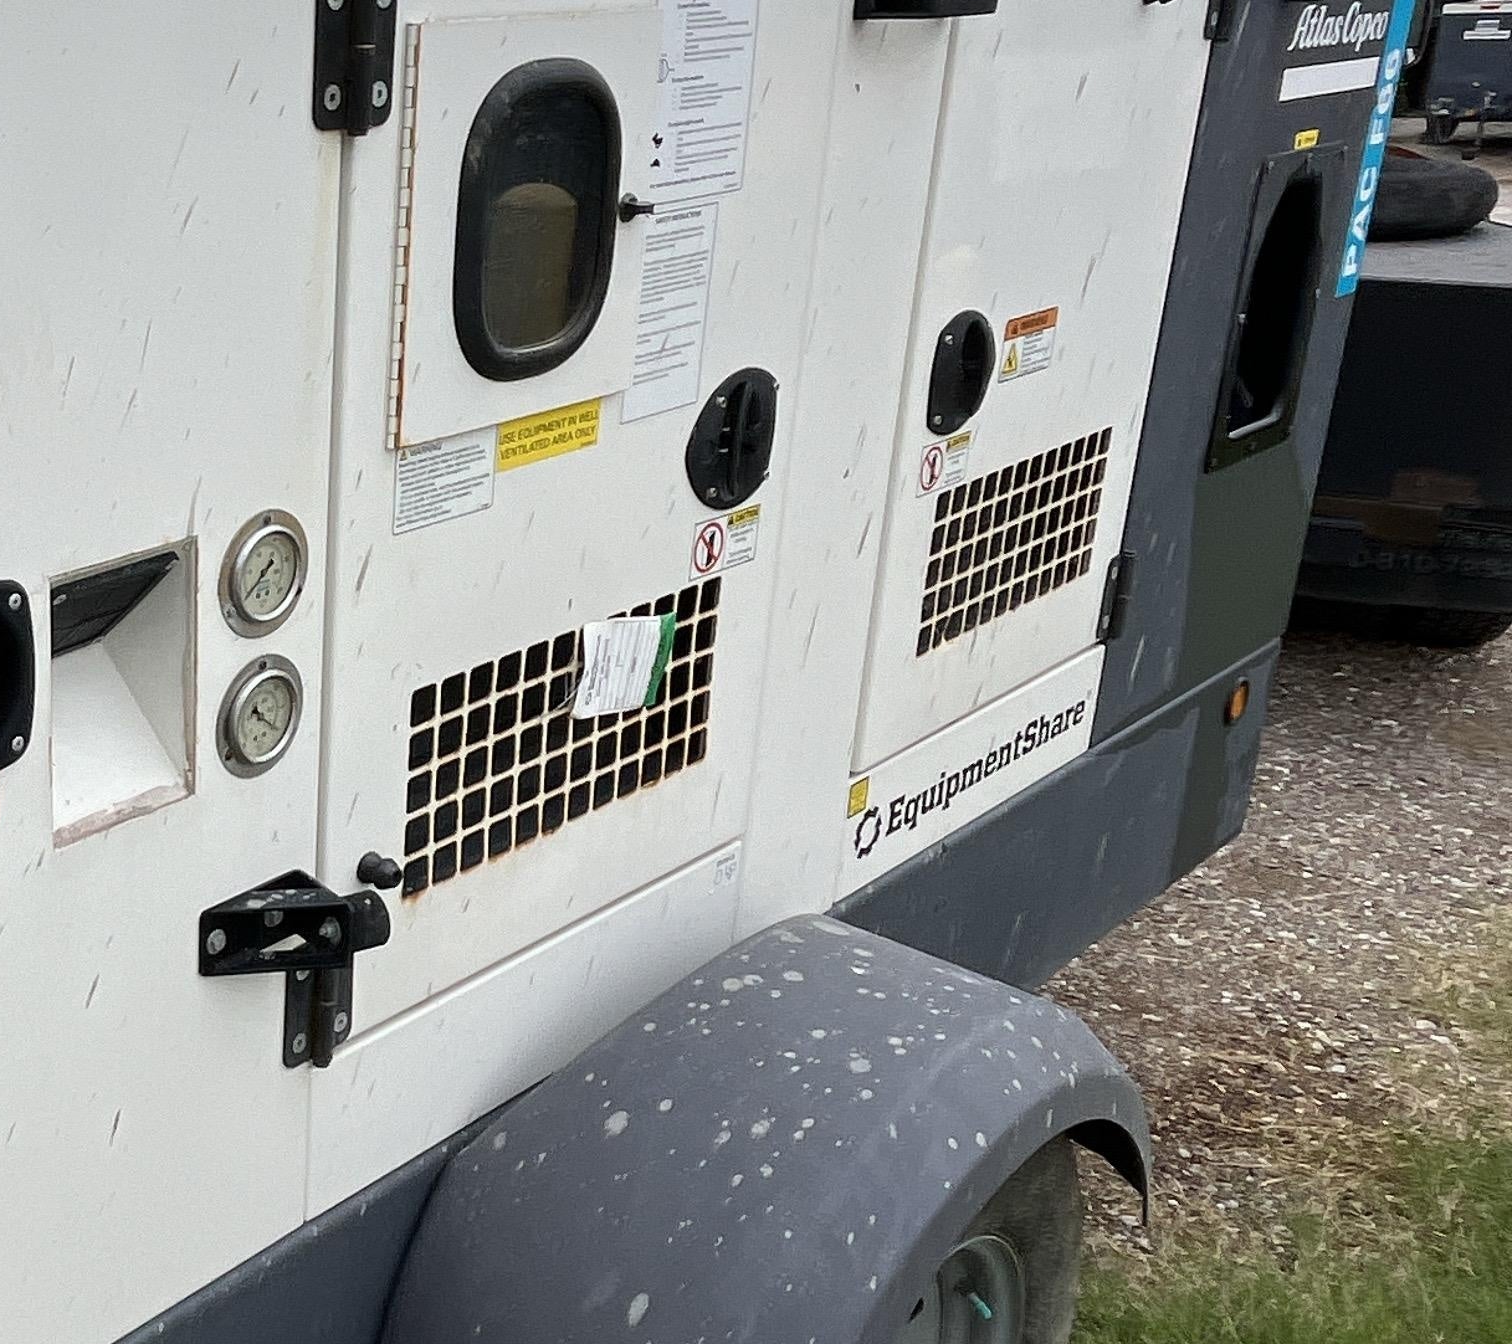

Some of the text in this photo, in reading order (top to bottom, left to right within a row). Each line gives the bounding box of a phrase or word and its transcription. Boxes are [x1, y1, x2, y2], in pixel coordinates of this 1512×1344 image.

[1286, 0, 1391, 53] Atlas Copco
[1341, 165, 1379, 278] PAC
[498, 409, 600, 446] USE EQUIPMENT IN WELL
[499, 436, 551, 461] VENTILATED
[551, 431, 575, 446] AREA
[574, 424, 598, 440] ONLY
[885, 699, 1086, 838] EquipmentShare
